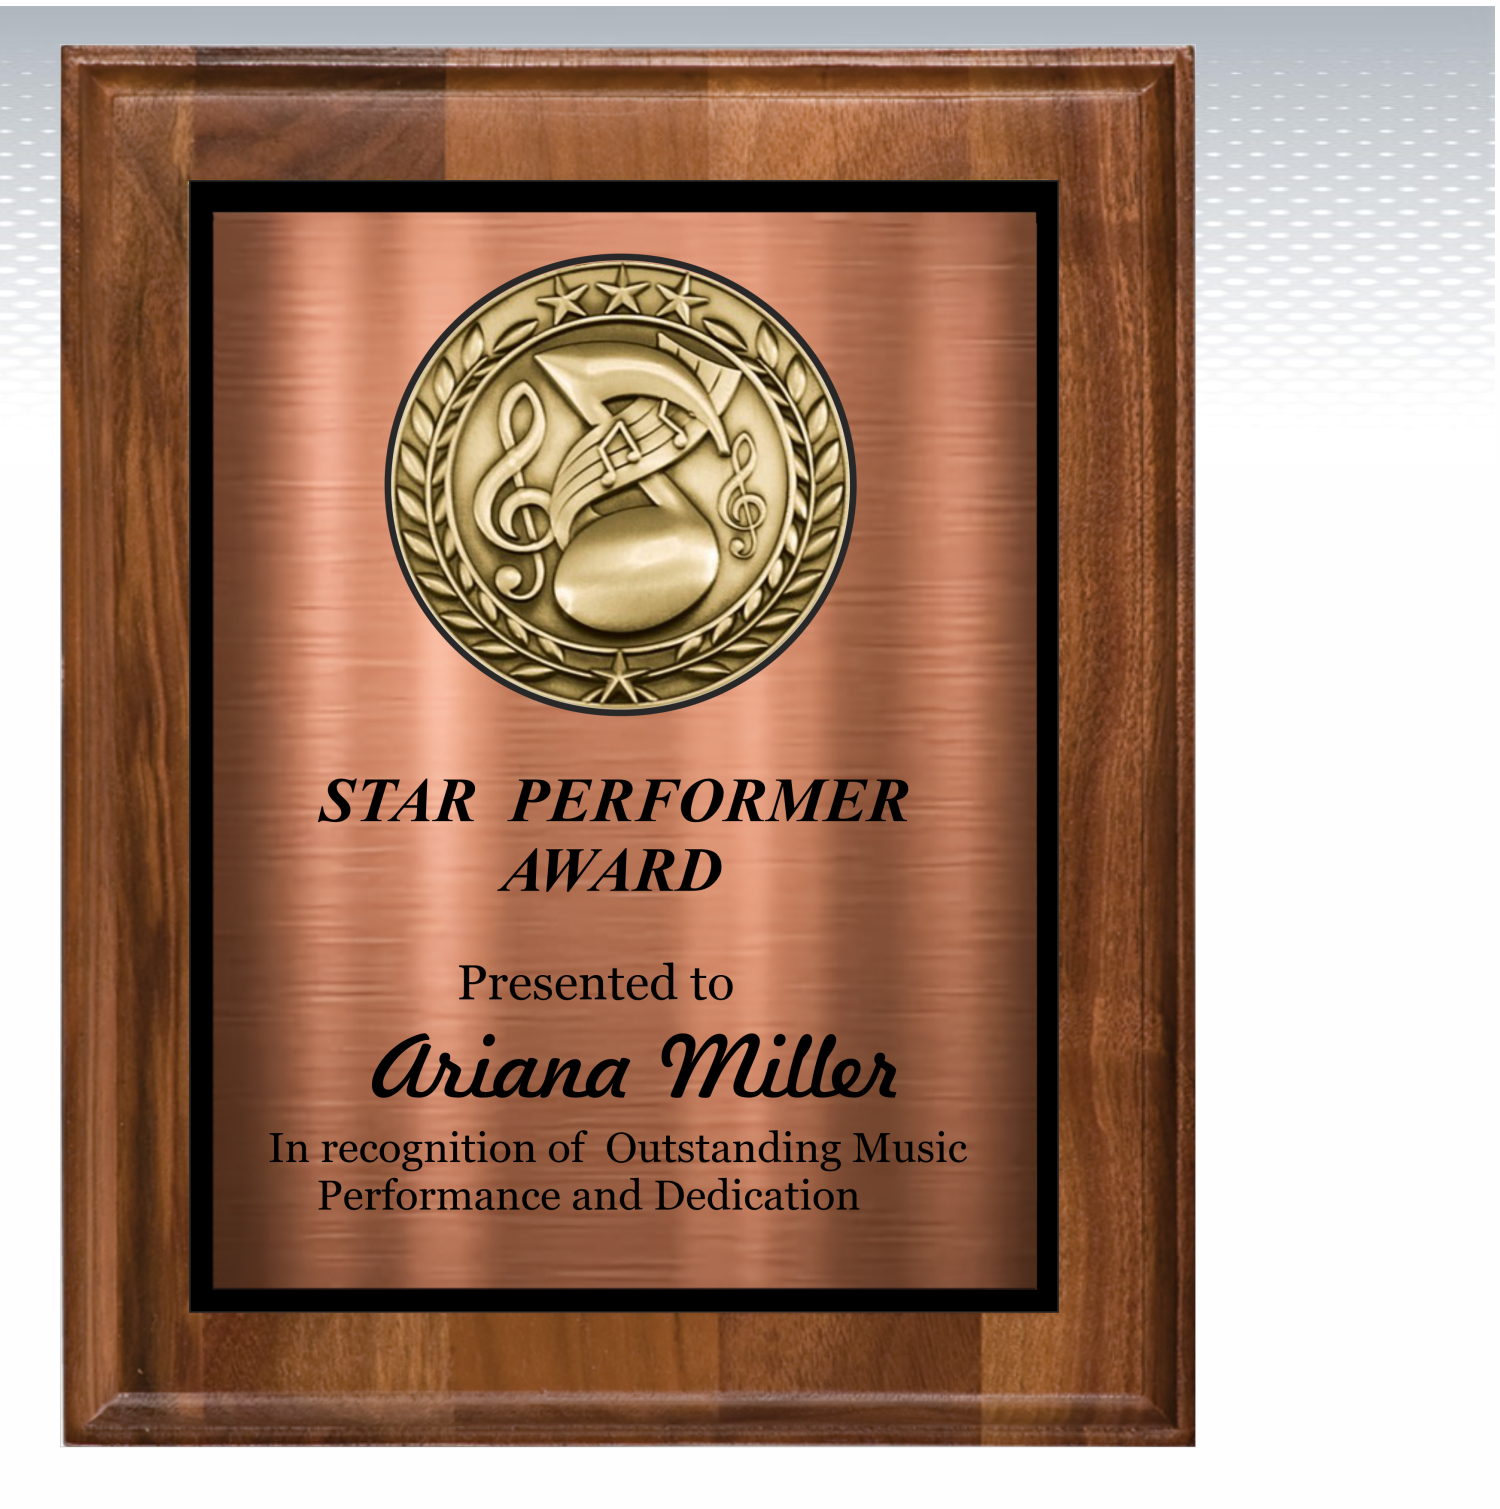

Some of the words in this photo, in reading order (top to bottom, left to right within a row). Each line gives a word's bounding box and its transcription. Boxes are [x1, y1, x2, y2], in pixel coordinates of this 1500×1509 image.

[317, 778, 476, 823] STAR
[506, 778, 909, 823] PERFORMER
[496, 847, 722, 893] AWARD
[458, 962, 678, 1001] Presented
[689, 967, 734, 1001] to
[371, 1032, 631, 1099] Ariana
[661, 1032, 897, 1099] Miller
[268, 1132, 310, 1163] In
[321, 1130, 537, 1172] recognition
[548, 1129, 589, 1164] of
[606, 1129, 842, 1172] Outstanding
[852, 1130, 968, 1164] Music
[318, 1177, 561, 1211] Performance
[572, 1177, 643, 1211] and
[654, 1177, 861, 1211] Dedication
